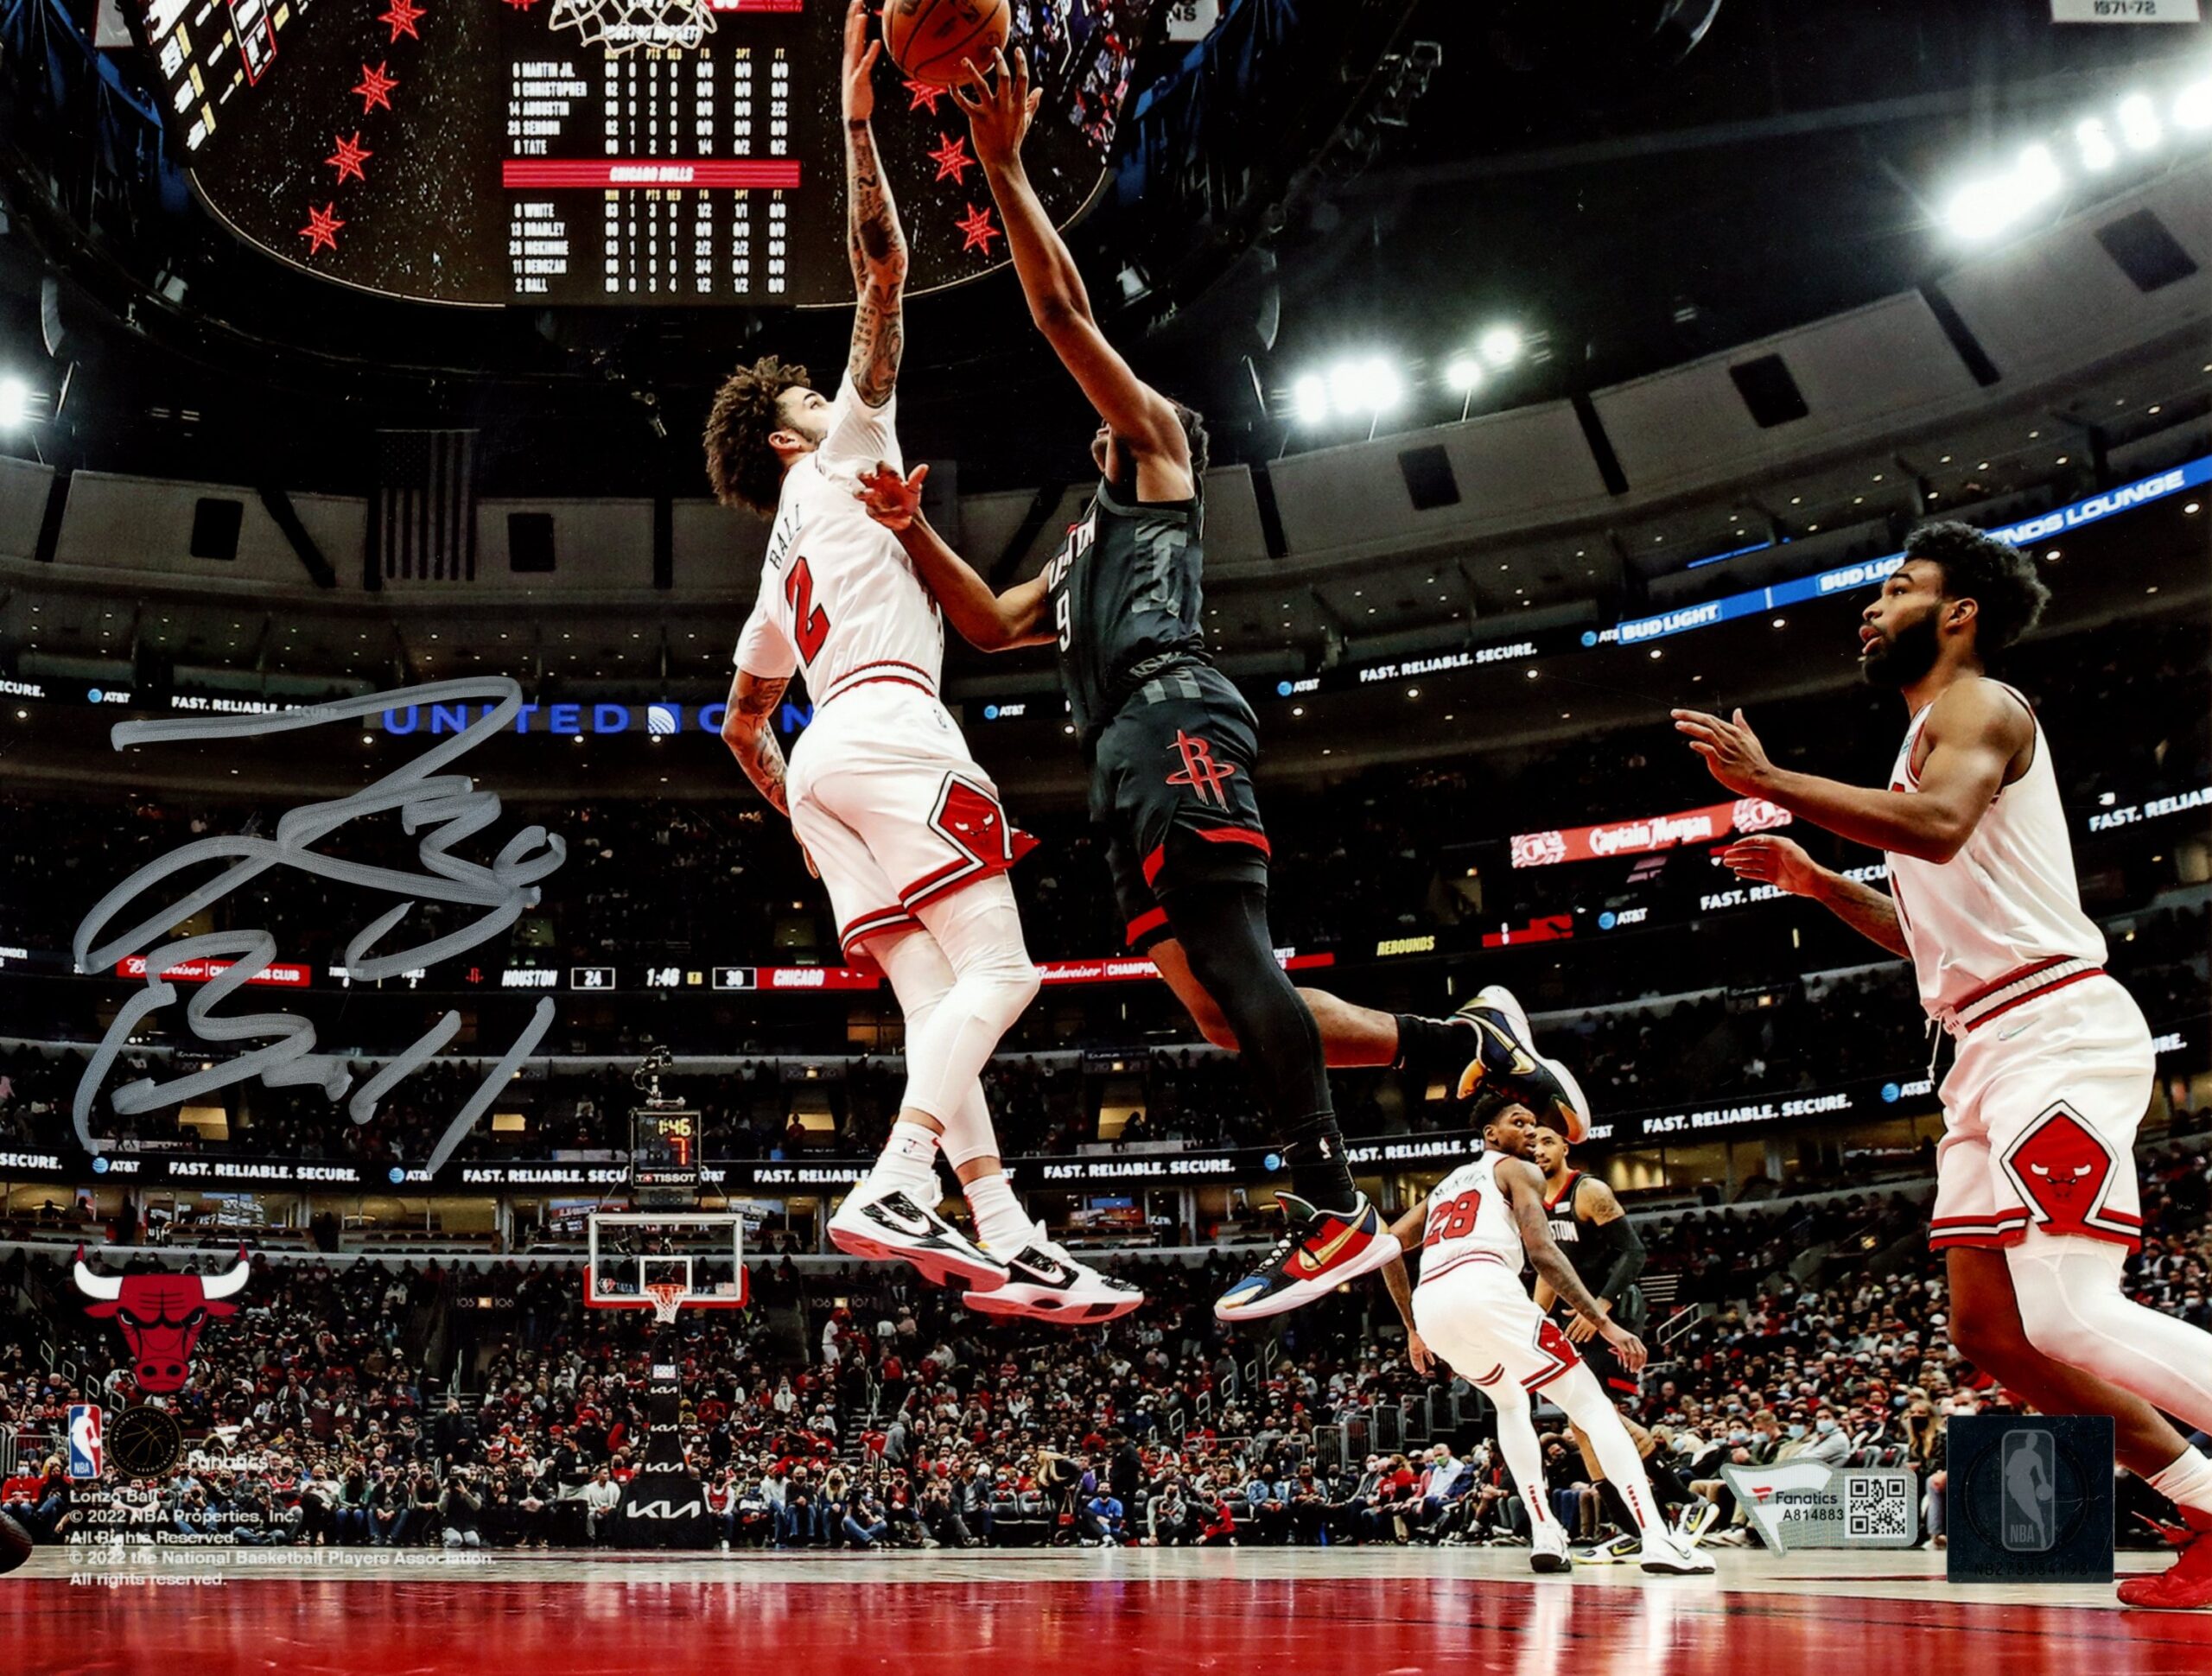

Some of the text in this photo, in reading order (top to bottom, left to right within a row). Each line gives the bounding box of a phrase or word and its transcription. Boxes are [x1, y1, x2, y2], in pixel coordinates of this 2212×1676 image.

[2065, 469, 2185, 527] LOUNGE
[769, 504, 801, 569] BALL
[1820, 569, 1864, 592] BUD
[785, 555, 830, 669] 2
[1056, 588, 1071, 652] 9
[1622, 604, 1719, 642] BUD LIGHT
[1360, 643, 1538, 682] FAST. RELIABLE. SECURE.
[1293, 679, 1320, 693] AT&T
[103, 691, 130, 704] AT&T
[171, 696, 209, 711] FAST.
[998, 704, 1026, 717] AT&T
[2088, 806, 2143, 833] FAST.
[1588, 816, 1713, 856] Captain Morgan
[1700, 890, 1748, 911] FAST.
[1616, 908, 1648, 925] AT&T
[1376, 936, 1435, 956] REBOUNDS
[272, 969, 300, 981] CLUB
[502, 969, 557, 987] HOUSTON
[584, 970, 602, 987] 24
[726, 970, 745, 987] 30
[772, 968, 825, 987] CHICAGO
[1643, 1093, 1853, 1134] FAST. RELIABLE. SECURE.
[658, 1118, 691, 1137] 1:46
[670, 1136, 688, 1166] 7
[1384, 1140, 1466, 1159] RELIABLE.
[0, 1152, 63, 1171] SECURE.
[109, 1159, 141, 1173] AT&T
[1044, 1159, 1236, 1179] FAST. RELIABLE. SECURE.
[168, 1162, 360, 1182] FAST. RELIABLE. SECURE.
[462, 1170, 505, 1183] FAST.
[507, 1169, 584, 1183] RELIABLE.
[654, 1173, 696, 1184] TISSOT
[753, 1169, 796, 1183] FAST.
[1423, 1189, 1481, 1247] 28
[645, 1462, 684, 1473] KIA
[1776, 1491, 1838, 1505] Fanatics
[626, 1500, 701, 1519] KIA
[1783, 1508, 1844, 1521] A814883
[2010, 1524, 2035, 1543] NBA
